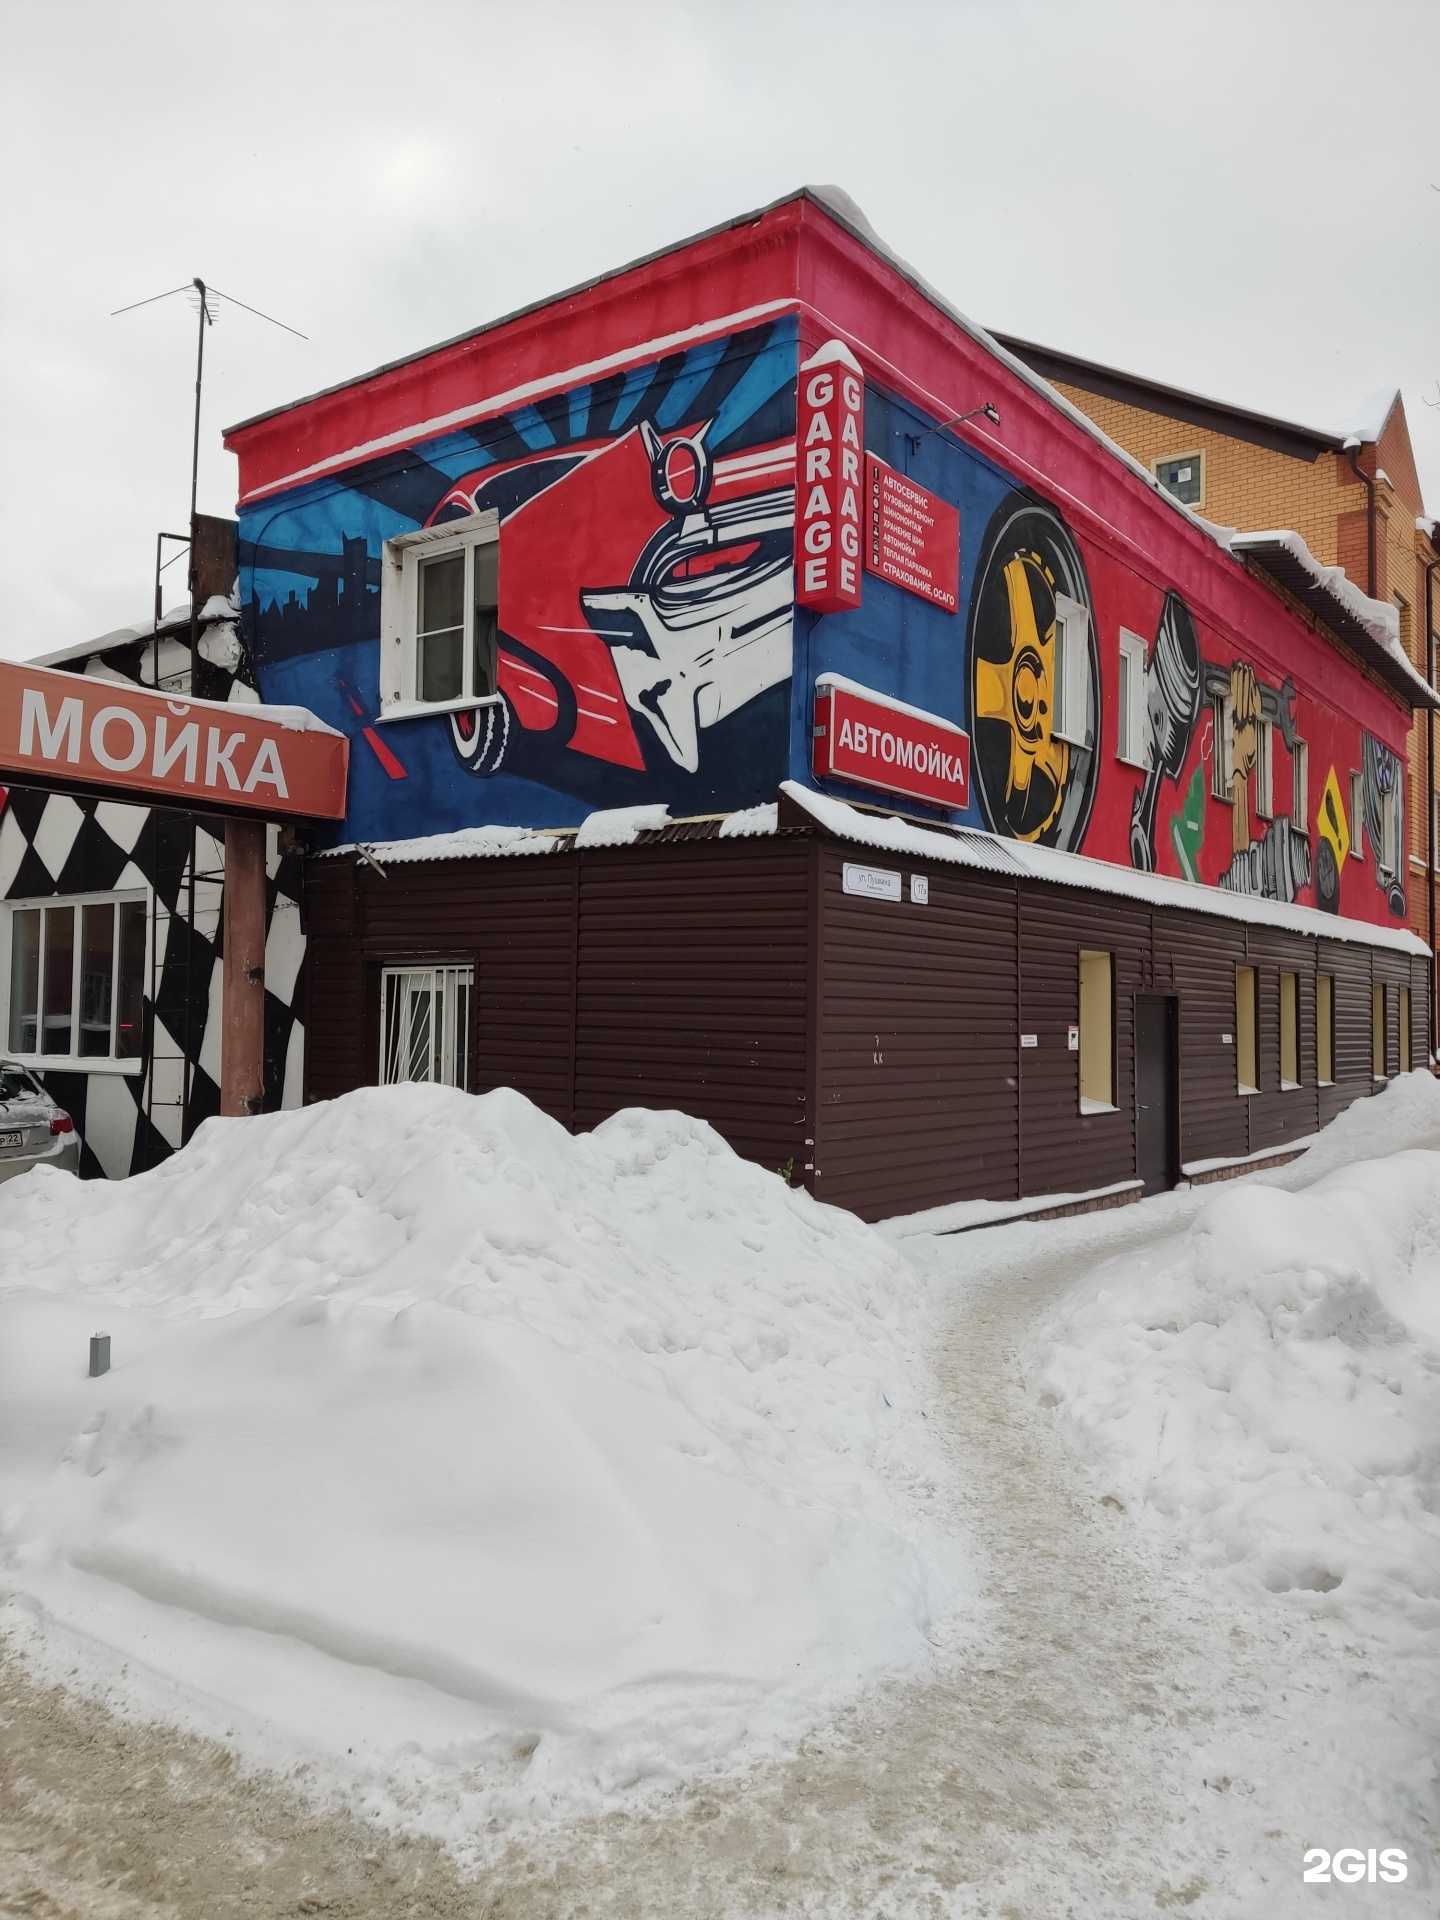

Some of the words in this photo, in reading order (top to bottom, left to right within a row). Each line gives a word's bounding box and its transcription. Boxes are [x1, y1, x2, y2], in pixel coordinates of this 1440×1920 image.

[803, 372, 834, 593] GARAGE
[840, 375, 860, 595] GARAGE
[883, 475, 929, 509] АВТОСЕРВИС
[883, 491, 913, 515] КУЗОВНОЙ
[913, 508, 935, 527] РЕМОНТ
[883, 506, 923, 534] ШИНОМОНТАЖ
[883, 520, 912, 541] ХРАНЕНИЕ
[883, 533, 917, 557] АВТОМОЙКА
[883, 546, 905, 566] ТЕПЛАЯ
[904, 559, 933, 579] ПАРКОВКА
[933, 587, 955, 606] ОСАГО
[18, 688, 289, 799] МОЙКА
[838, 718, 965, 786] АВТОМОЙКА
